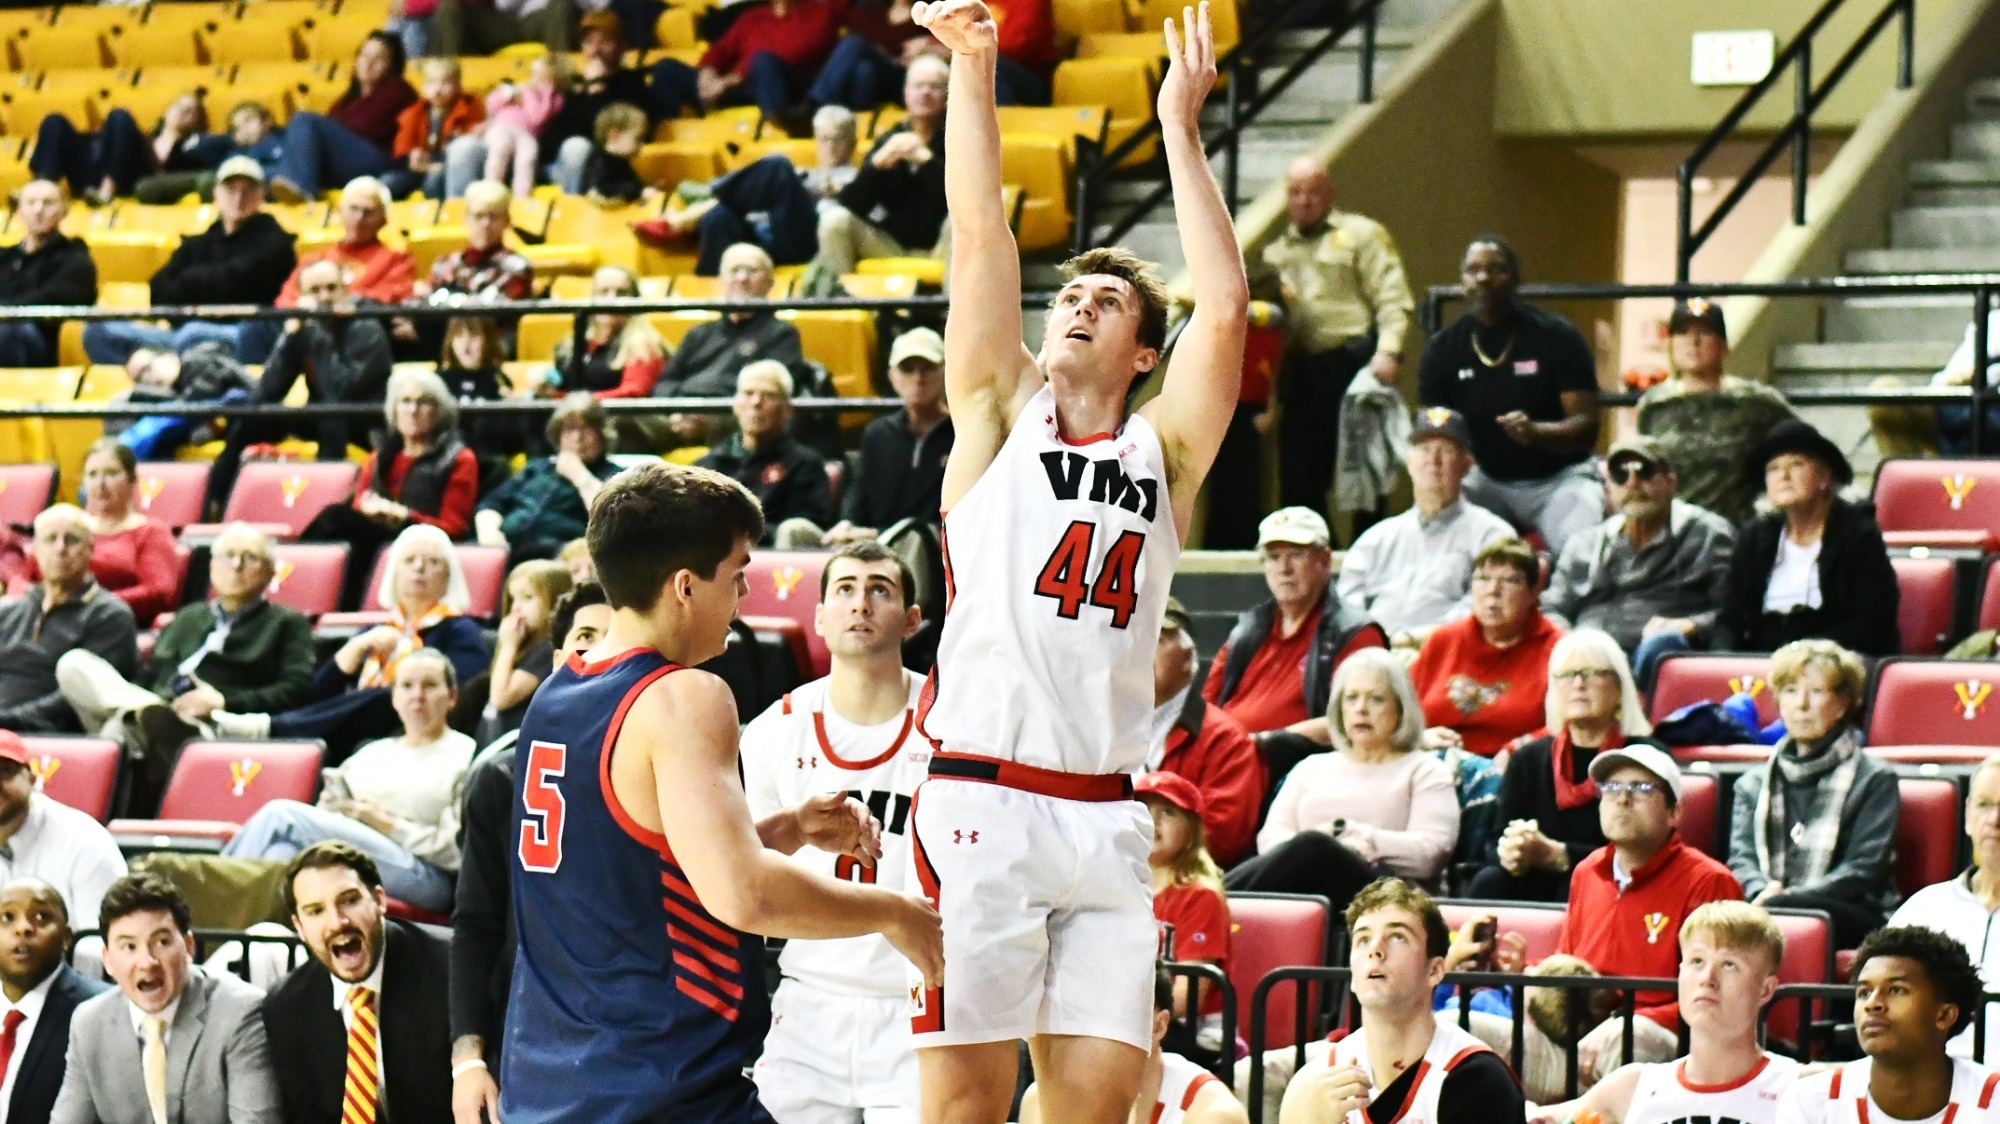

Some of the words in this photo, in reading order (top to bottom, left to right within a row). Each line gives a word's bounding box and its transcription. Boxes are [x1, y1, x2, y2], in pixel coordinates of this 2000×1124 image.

[1039, 451, 1158, 523] VMI
[1034, 520, 1146, 630] 44
[518, 740, 567, 874] 5
